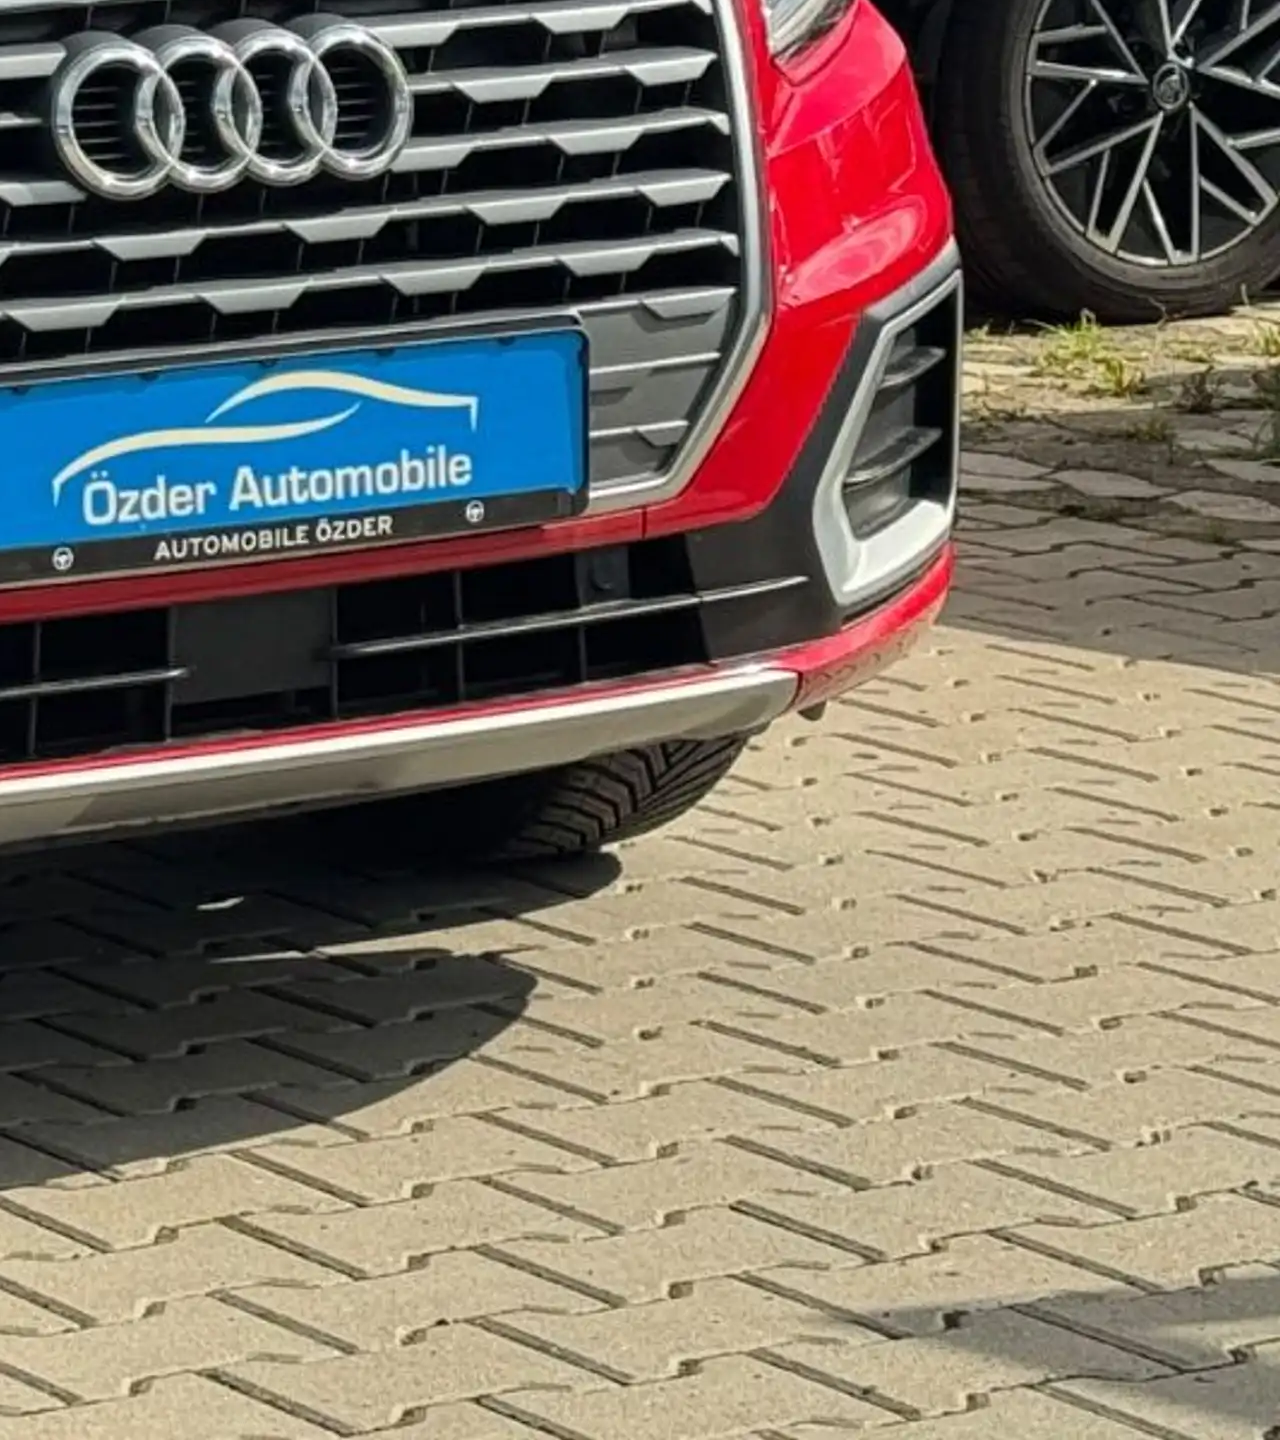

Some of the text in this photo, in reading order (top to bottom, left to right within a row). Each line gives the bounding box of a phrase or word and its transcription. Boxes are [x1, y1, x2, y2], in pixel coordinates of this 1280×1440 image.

[82, 444, 473, 526] Özder Automobile
[153, 514, 394, 561] AUTOMOBILE ÖZDER
